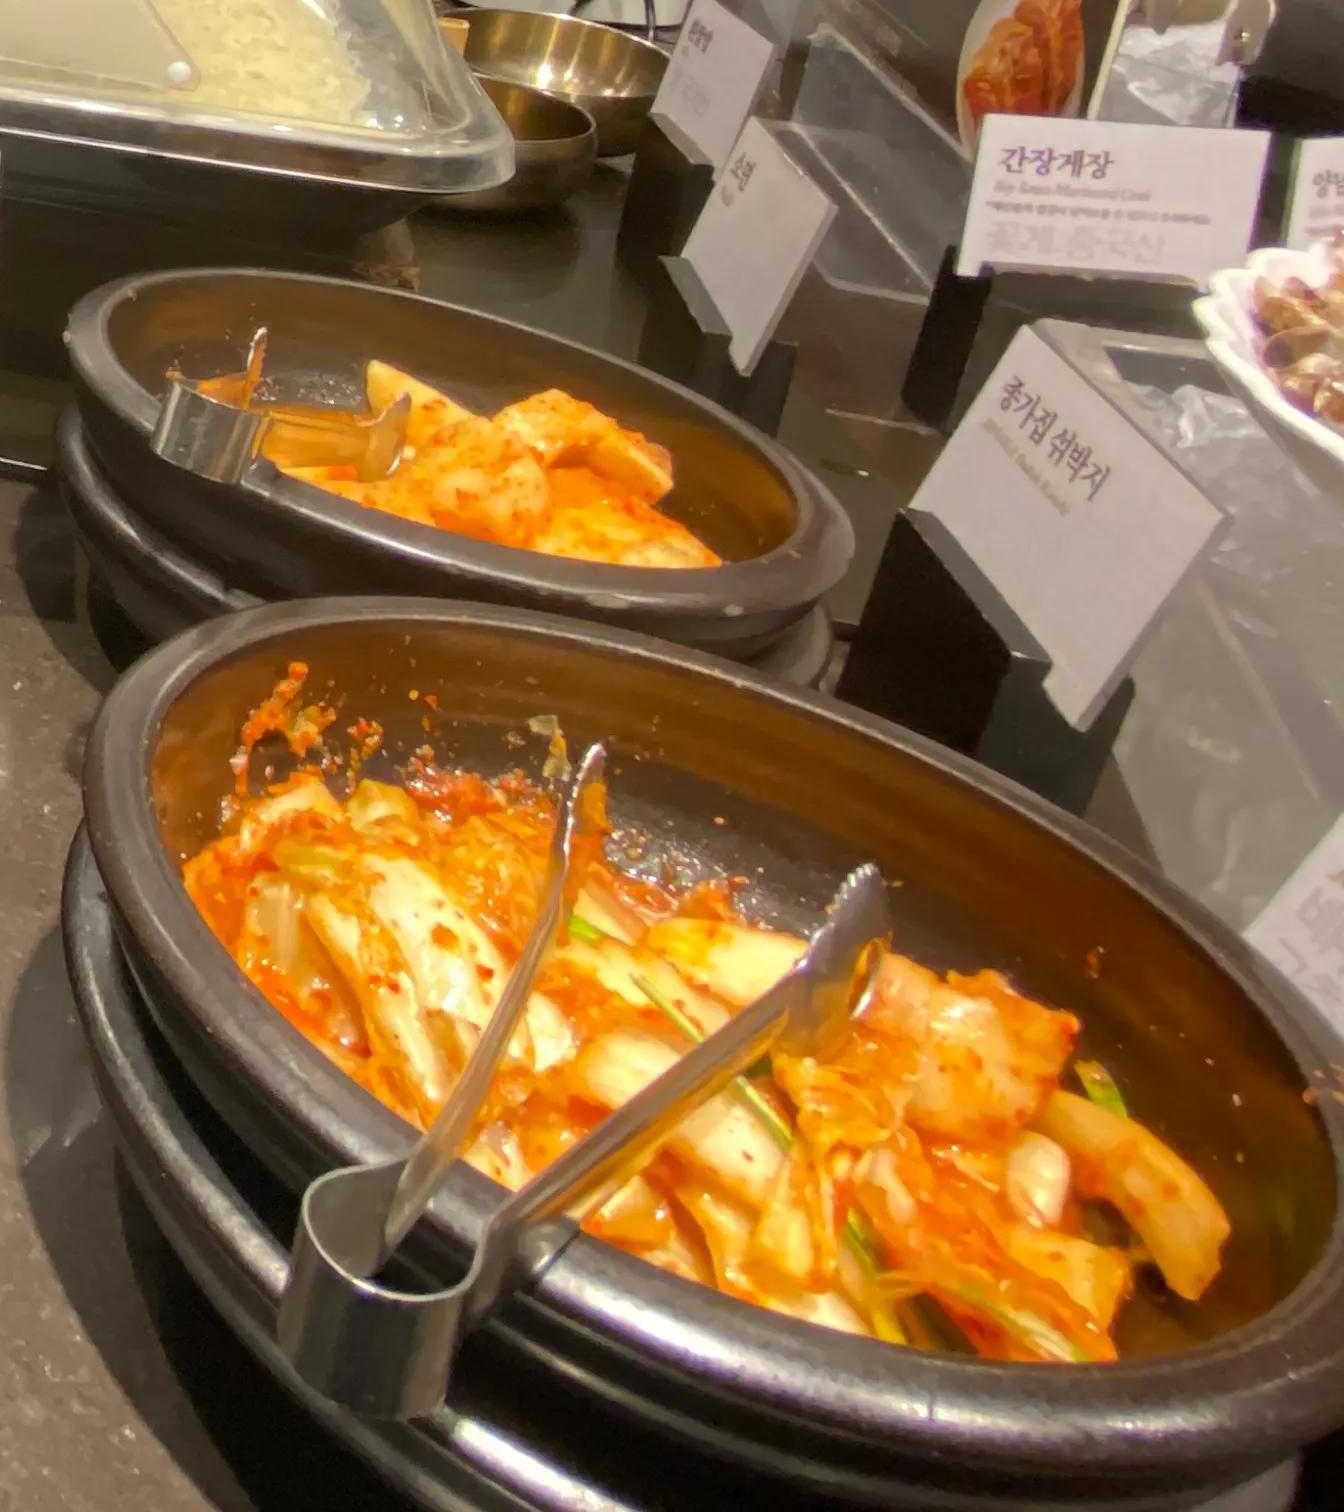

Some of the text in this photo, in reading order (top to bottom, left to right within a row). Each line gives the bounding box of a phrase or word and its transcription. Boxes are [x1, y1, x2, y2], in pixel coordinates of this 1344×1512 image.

[999, 145, 1115, 180] 간장게장
[1000, 375, 1058, 447] 종가집
[1047, 428, 1111, 501] 섞박지
